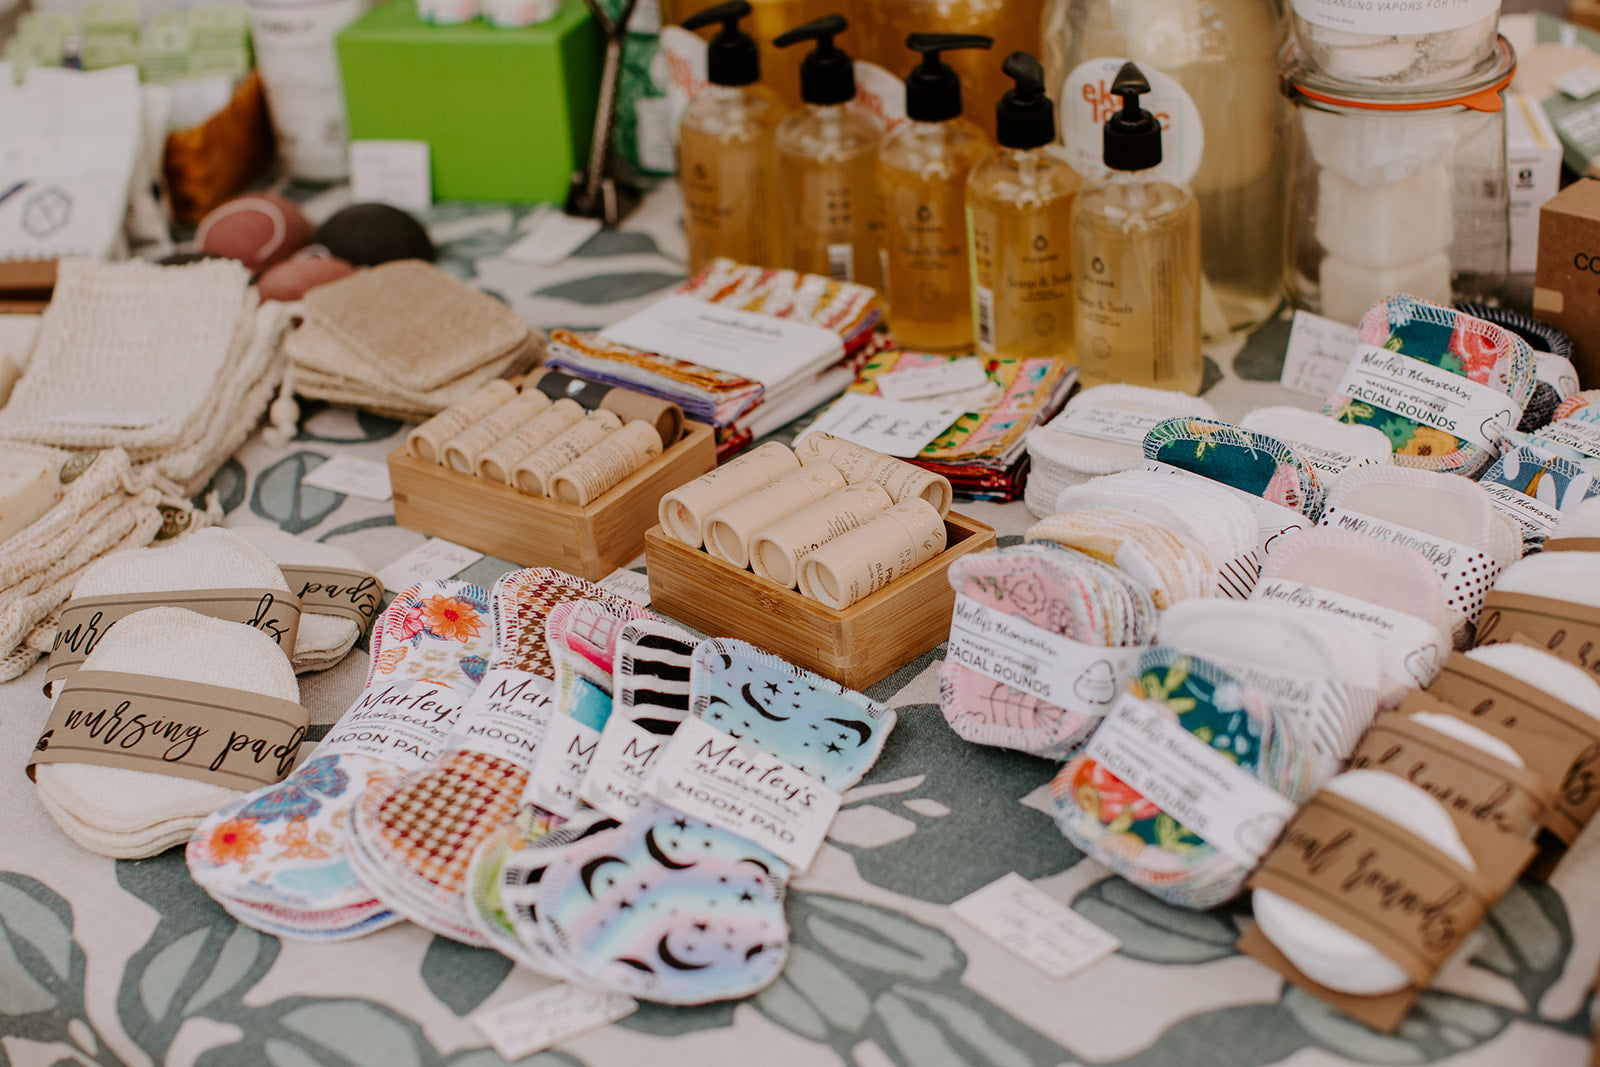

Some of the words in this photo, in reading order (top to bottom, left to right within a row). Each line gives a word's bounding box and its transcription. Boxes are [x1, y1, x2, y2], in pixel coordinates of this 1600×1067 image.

[1377, 2, 1422, 12] VAPORS
[1347, 383, 1392, 408] FACIAL
[1396, 400, 1457, 432] ROUNDS
[1541, 432, 1584, 449] FACIAL
[297, 576, 377, 618] pads
[949, 642, 989, 672] FACIAL
[993, 662, 1051, 698] ROUNDS
[64, 700, 209, 762] nursing
[327, 731, 389, 746] MOON
[467, 724, 537, 752] MOON
[696, 738, 818, 807] Marley's
[675, 780, 745, 816] MOON
[751, 814, 795, 843] PAD
